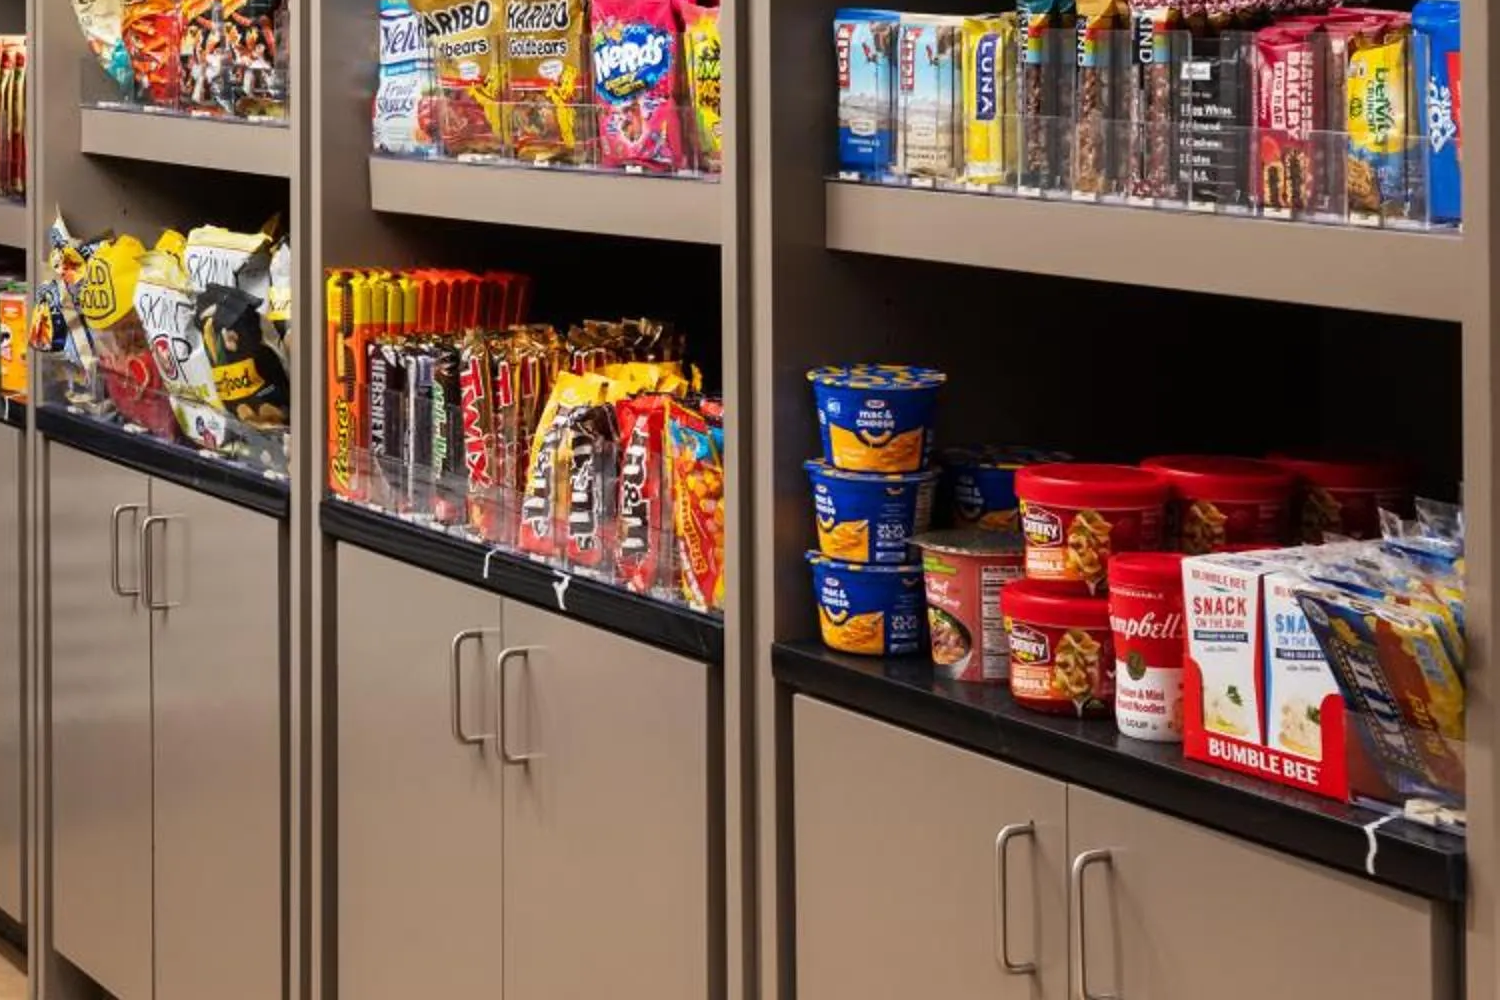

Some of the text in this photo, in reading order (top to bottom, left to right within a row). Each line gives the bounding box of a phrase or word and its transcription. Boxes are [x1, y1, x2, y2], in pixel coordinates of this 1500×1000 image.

[981, 39, 996, 113] LUNA
[1287, 50, 1301, 141] BAKERY
[371, 358, 386, 457] HERSHEY'S
[460, 356, 493, 488] TWIX
[1193, 596, 1247, 616] SNACK
[1275, 613, 1308, 633] SNA
[1208, 737, 1319, 786] BUMBLE BEE
